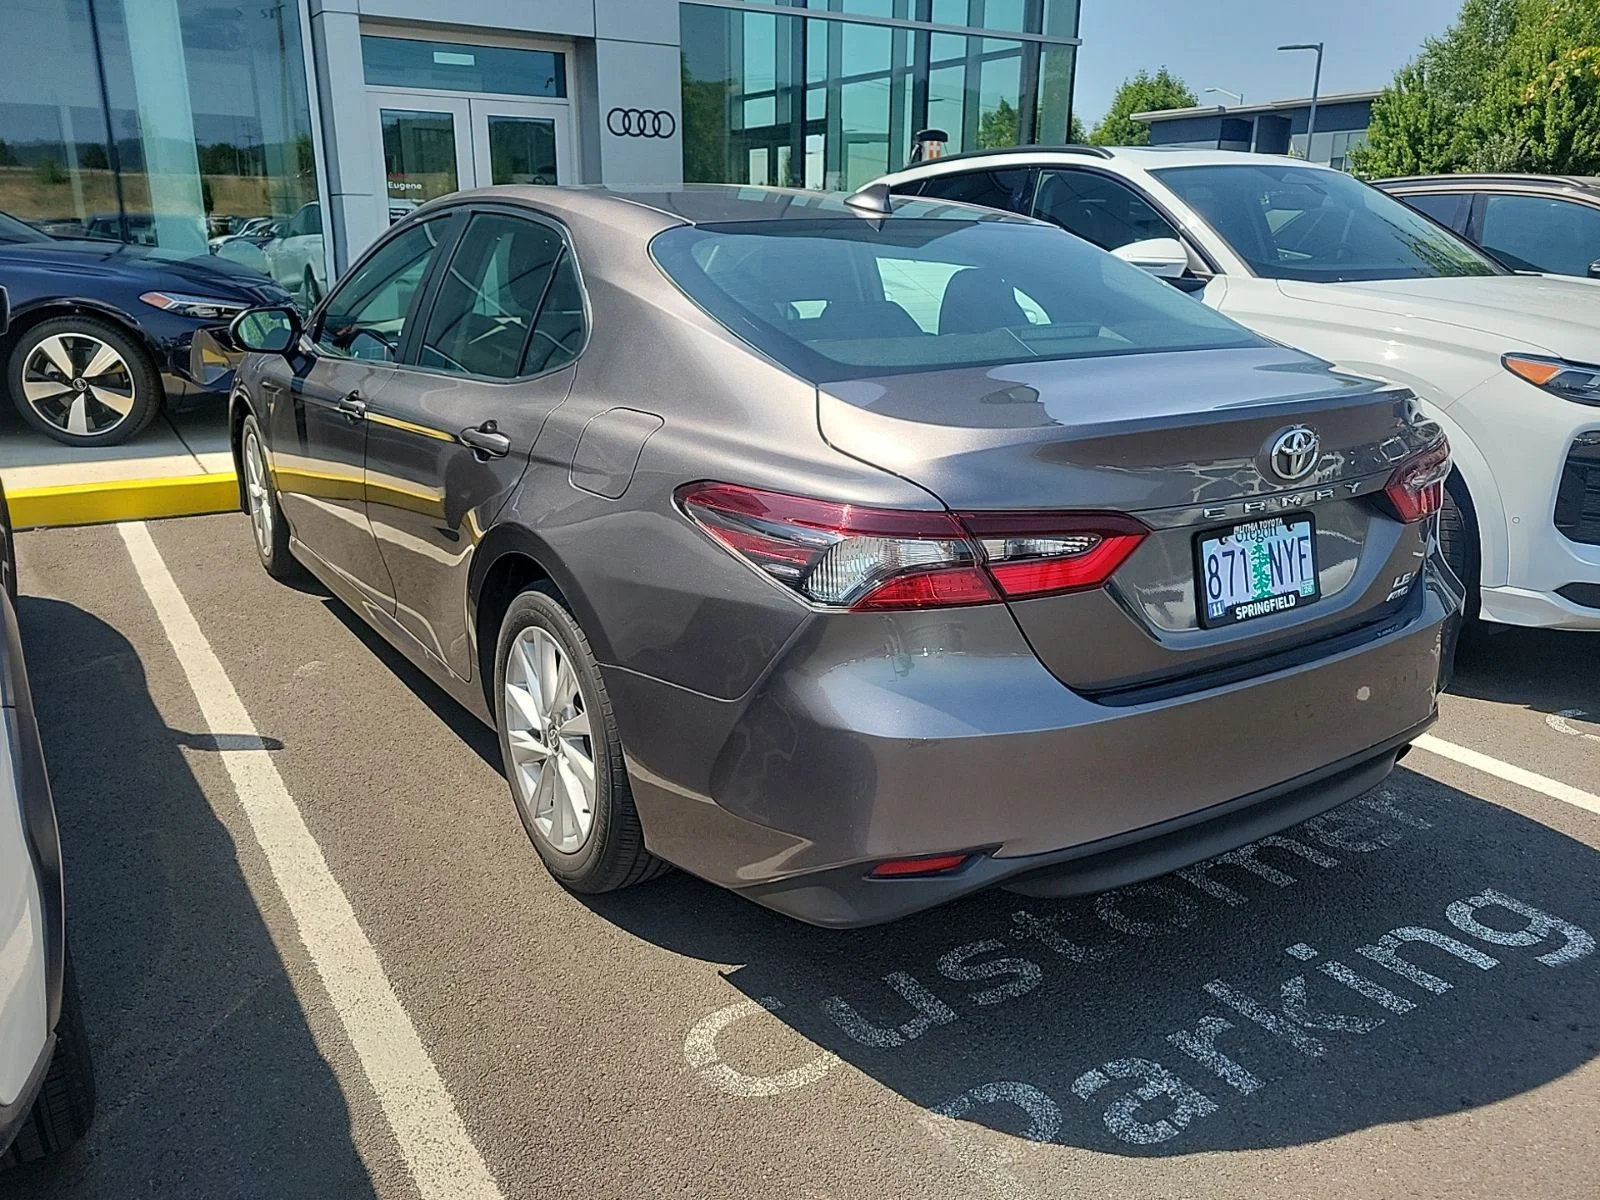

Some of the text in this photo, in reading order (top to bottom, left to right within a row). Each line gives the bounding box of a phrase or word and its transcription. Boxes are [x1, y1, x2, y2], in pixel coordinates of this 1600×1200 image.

[388, 181, 422, 191] Eugene
[1203, 482, 1361, 518] CAMRY
[1259, 517, 1283, 530] TOYOTA
[1208, 536, 1309, 600] 871 NYF
[1393, 572, 1411, 588] LE
[1235, 594, 1296, 620] SPRINGFIELD
[684, 789, 1432, 1097] Customer
